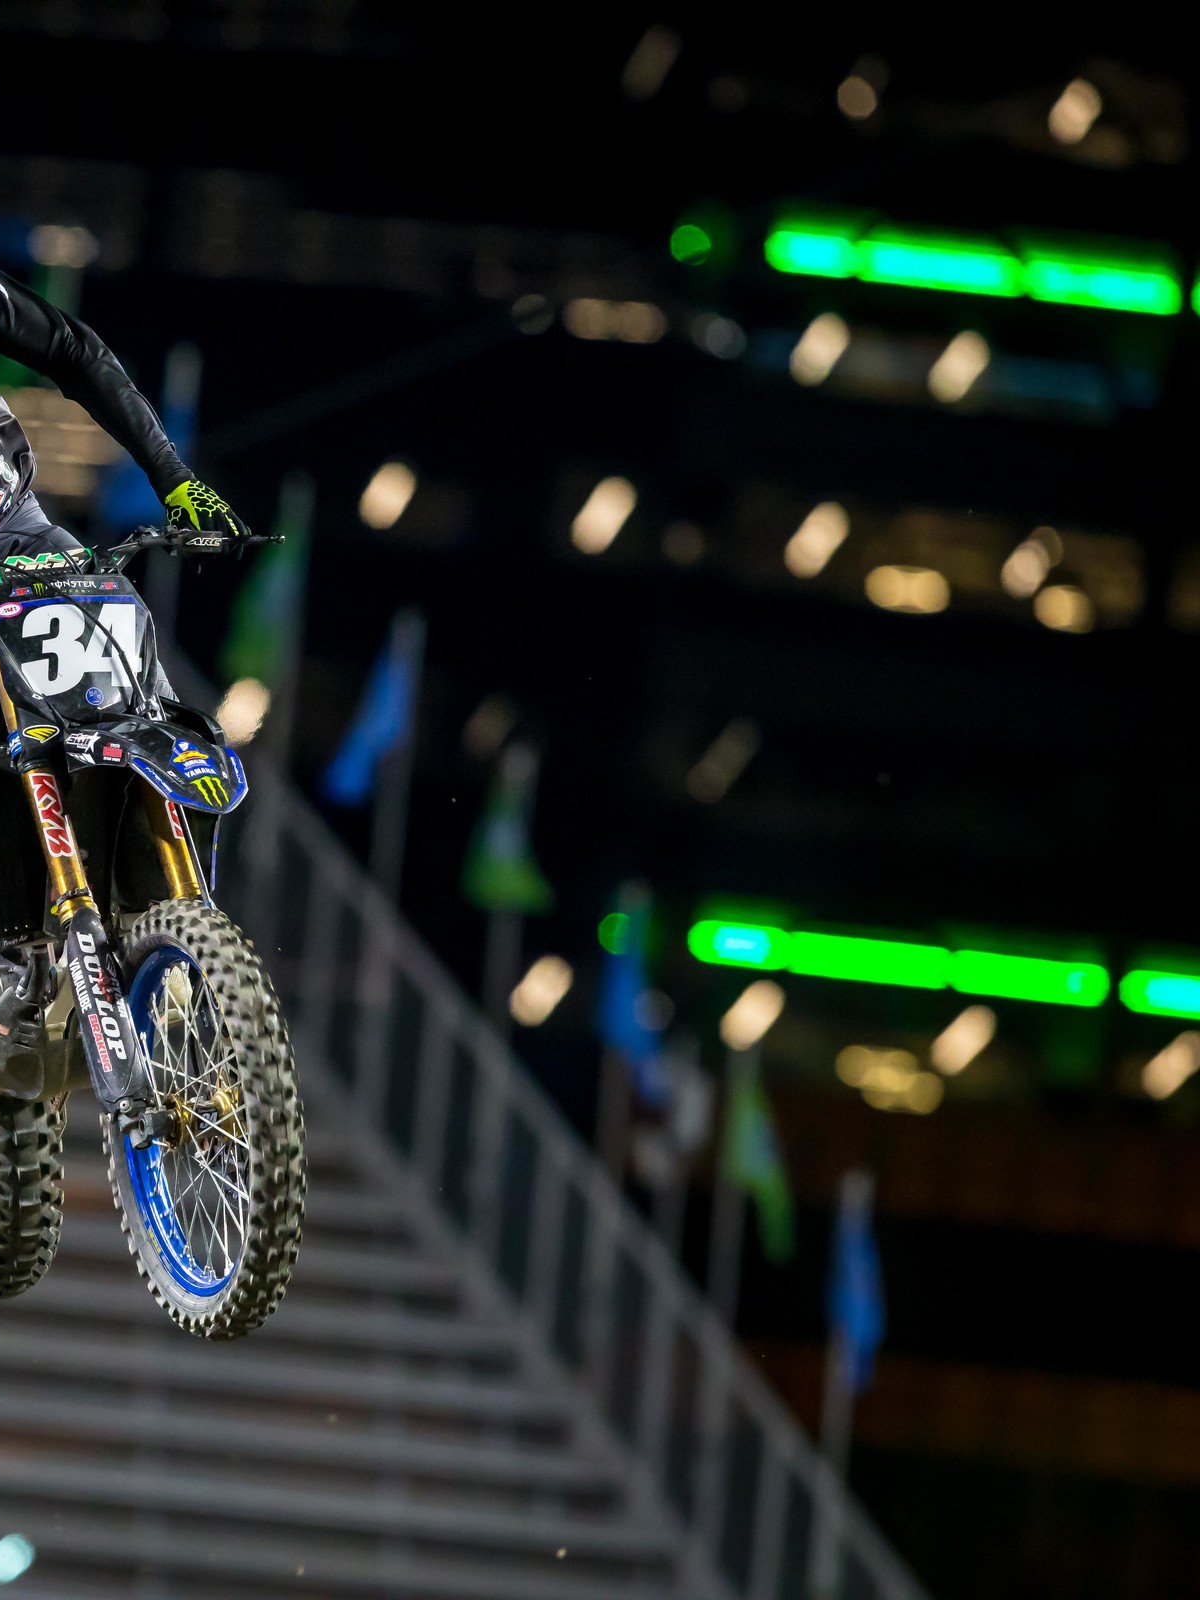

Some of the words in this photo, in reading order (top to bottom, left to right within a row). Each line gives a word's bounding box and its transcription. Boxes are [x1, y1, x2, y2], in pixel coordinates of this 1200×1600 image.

[185, 537, 222, 547] ARC
[45, 579, 97, 590] ONSTER
[21, 603, 143, 697] 34
[184, 768, 217, 778] YAMAHA
[29, 773, 75, 858] KYB
[68, 957, 93, 1015] YAMALUBE
[76, 931, 127, 1060] DUNLOP
[87, 1013, 113, 1073] BRAKING
